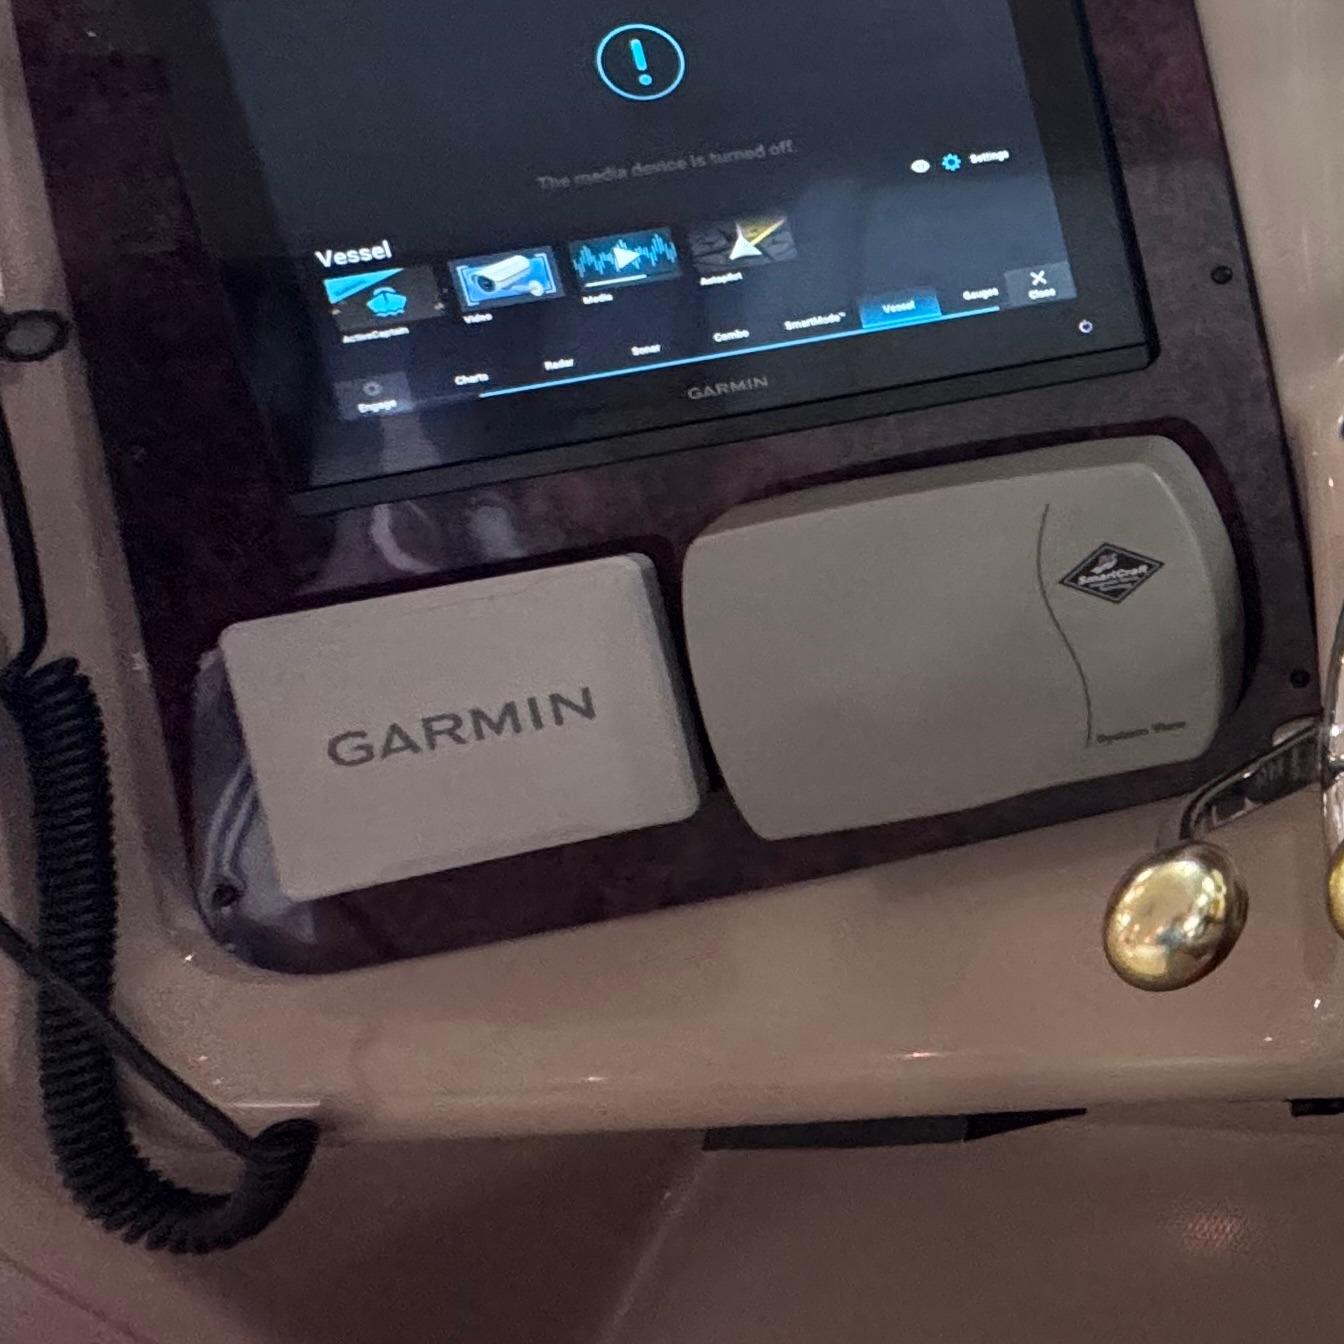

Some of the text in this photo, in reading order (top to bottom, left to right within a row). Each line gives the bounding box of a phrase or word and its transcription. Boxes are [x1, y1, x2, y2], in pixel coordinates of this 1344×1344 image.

[535, 139, 798, 191] The media device is turned off.
[315, 240, 393, 268] Vessel
[582, 293, 614, 305] Media
[962, 286, 999, 302] Gauges
[1028, 287, 1056, 300] Close
[882, 299, 916, 314] Vessel
[462, 312, 494, 325] Video
[712, 329, 750, 343] Combo
[630, 344, 662, 357] Sonar
[543, 358, 575, 371] Radar
[454, 372, 490, 386] Charts
[687, 375, 769, 400] GARMIN
[326, 686, 597, 768] GARMIN
